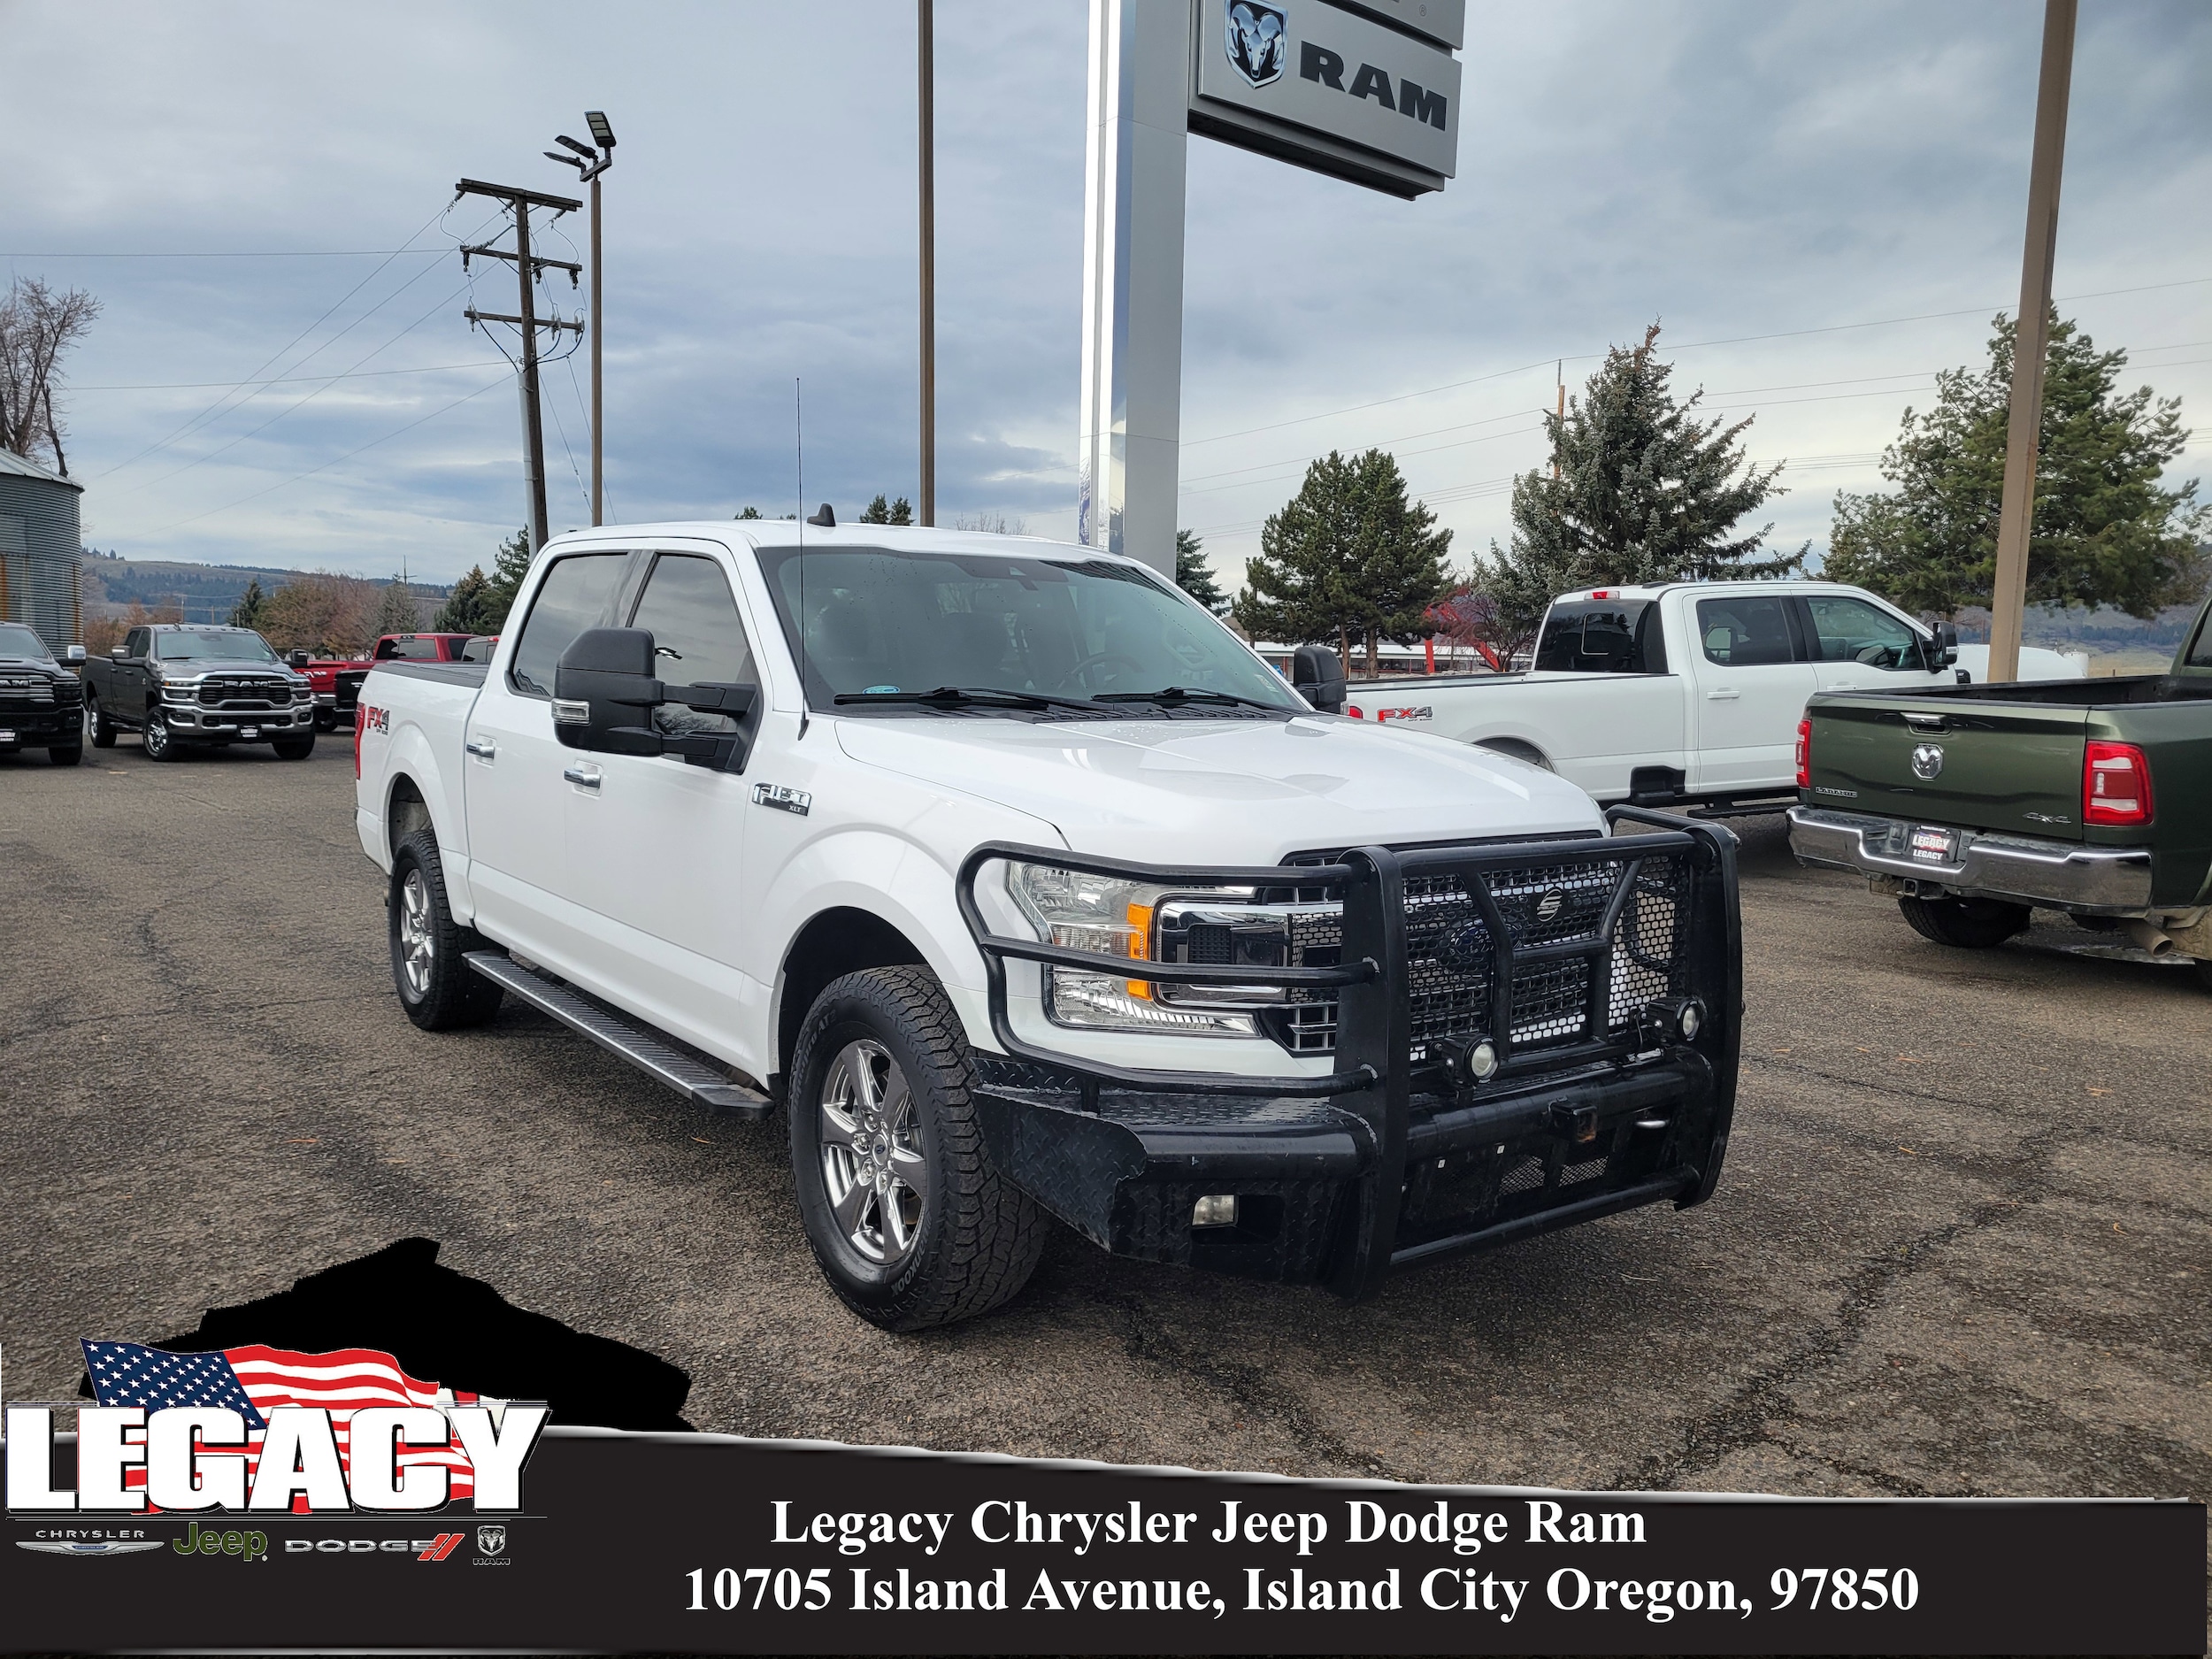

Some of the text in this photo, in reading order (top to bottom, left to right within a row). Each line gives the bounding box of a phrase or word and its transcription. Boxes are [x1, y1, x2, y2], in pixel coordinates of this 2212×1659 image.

[1300, 41, 1448, 131] RAM
[367, 706, 390, 730] FX4
[1378, 706, 1433, 723] FX4
[788, 804, 802, 813] XLT
[1912, 834, 1950, 850] LEGACY
[1913, 849, 1943, 861] LEGACY
